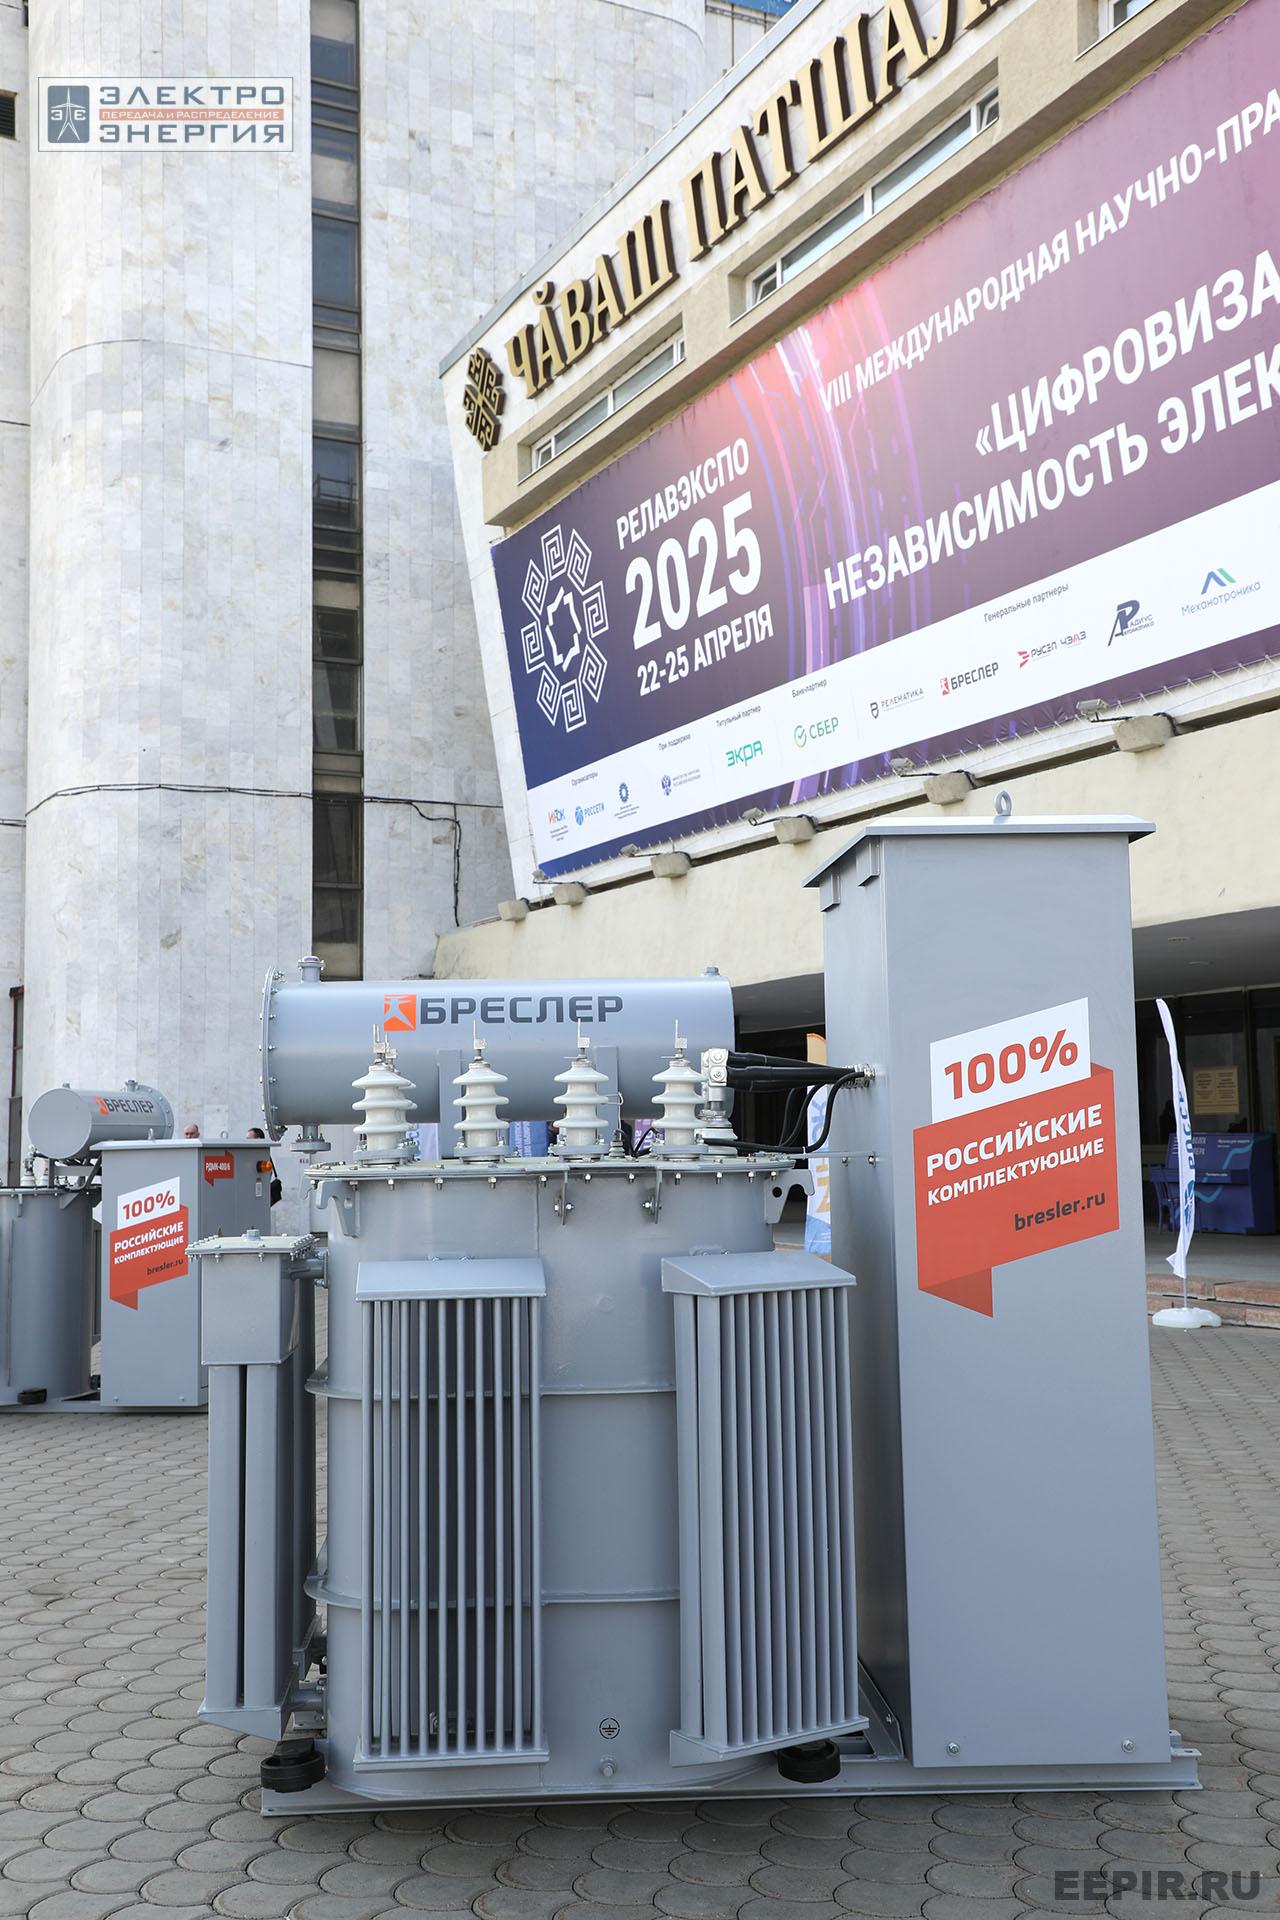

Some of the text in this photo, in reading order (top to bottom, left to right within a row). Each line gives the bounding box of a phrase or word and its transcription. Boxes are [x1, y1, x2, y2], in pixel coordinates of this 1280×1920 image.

[818, 88, 1280, 413] VIII МЕЖДУНАРОДНАЯ НАУЧНО-ПРА
[975, 248, 1280, 456] «ЦИФРОВИЗА
[616, 437, 750, 550] РЕЛАВЭКСПО
[824, 343, 1280, 610] НЕЗАВИСИМОСТЬ ЭЛЕК
[625, 491, 762, 650] 2025
[984, 584, 1069, 623] Генеральные партнеры
[1181, 581, 1262, 616] Механотроника
[637, 603, 774, 696] 22-25 АПРЕЛЯ
[951, 662, 999, 690] БРЕСЛЕР
[809, 717, 839, 739] СБЕР
[420, 995, 623, 1025] БРЕСЛЕР
[944, 1028, 1079, 1100] 100%
[104, 1098, 154, 1113] БРЕСЛЕР
[927, 1103, 1102, 1177] РОССИЙСКИЕ
[927, 1138, 1104, 1206] КОМПЛЕКТУЮЩИЕ
[122, 1190, 175, 1220] 100%
[1014, 1192, 1106, 1231] bresler.ru
[114, 1221, 184, 1253] РОССИЙСКИЕ
[114, 1235, 184, 1265] КОМПЛЕКТУЮЩИЕ
[146, 1257, 184, 1276] bresler.ru
